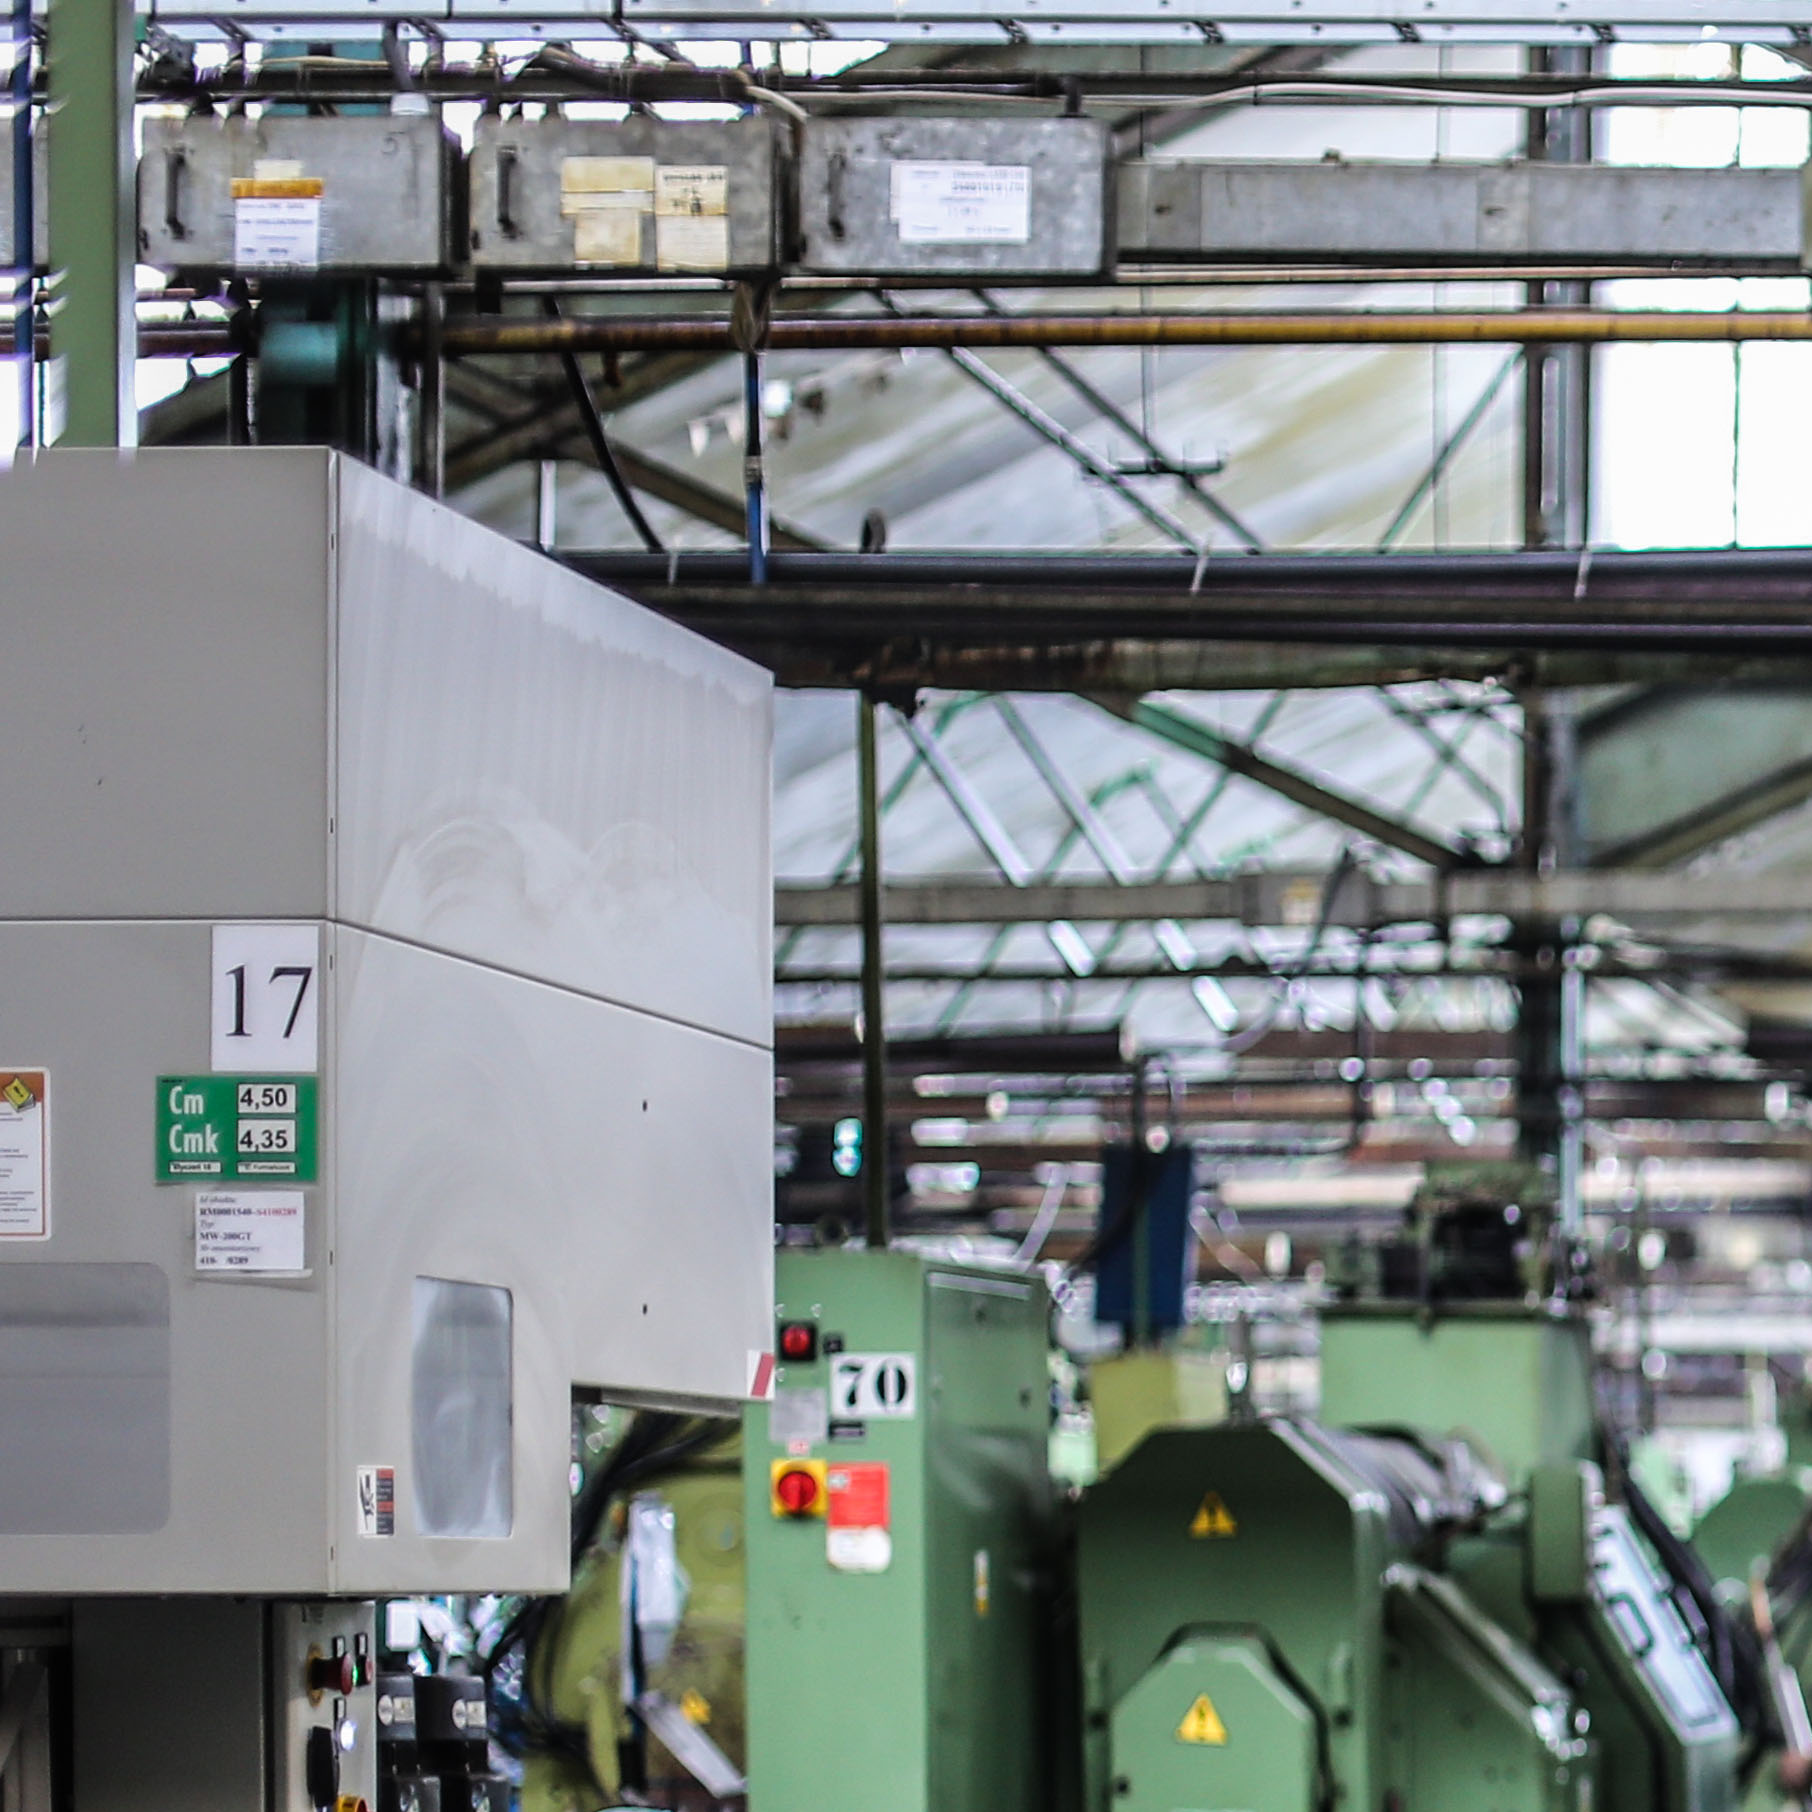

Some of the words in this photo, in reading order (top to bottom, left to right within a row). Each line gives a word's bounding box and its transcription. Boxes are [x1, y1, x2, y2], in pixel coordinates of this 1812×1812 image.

[224, 964, 313, 1039] 17
[169, 1085, 204, 1115] Cm
[240, 1088, 288, 1110] 4,50
[169, 1124, 219, 1153] Cmk
[240, 1130, 288, 1152] 4,35
[838, 1357, 907, 1413] 70
